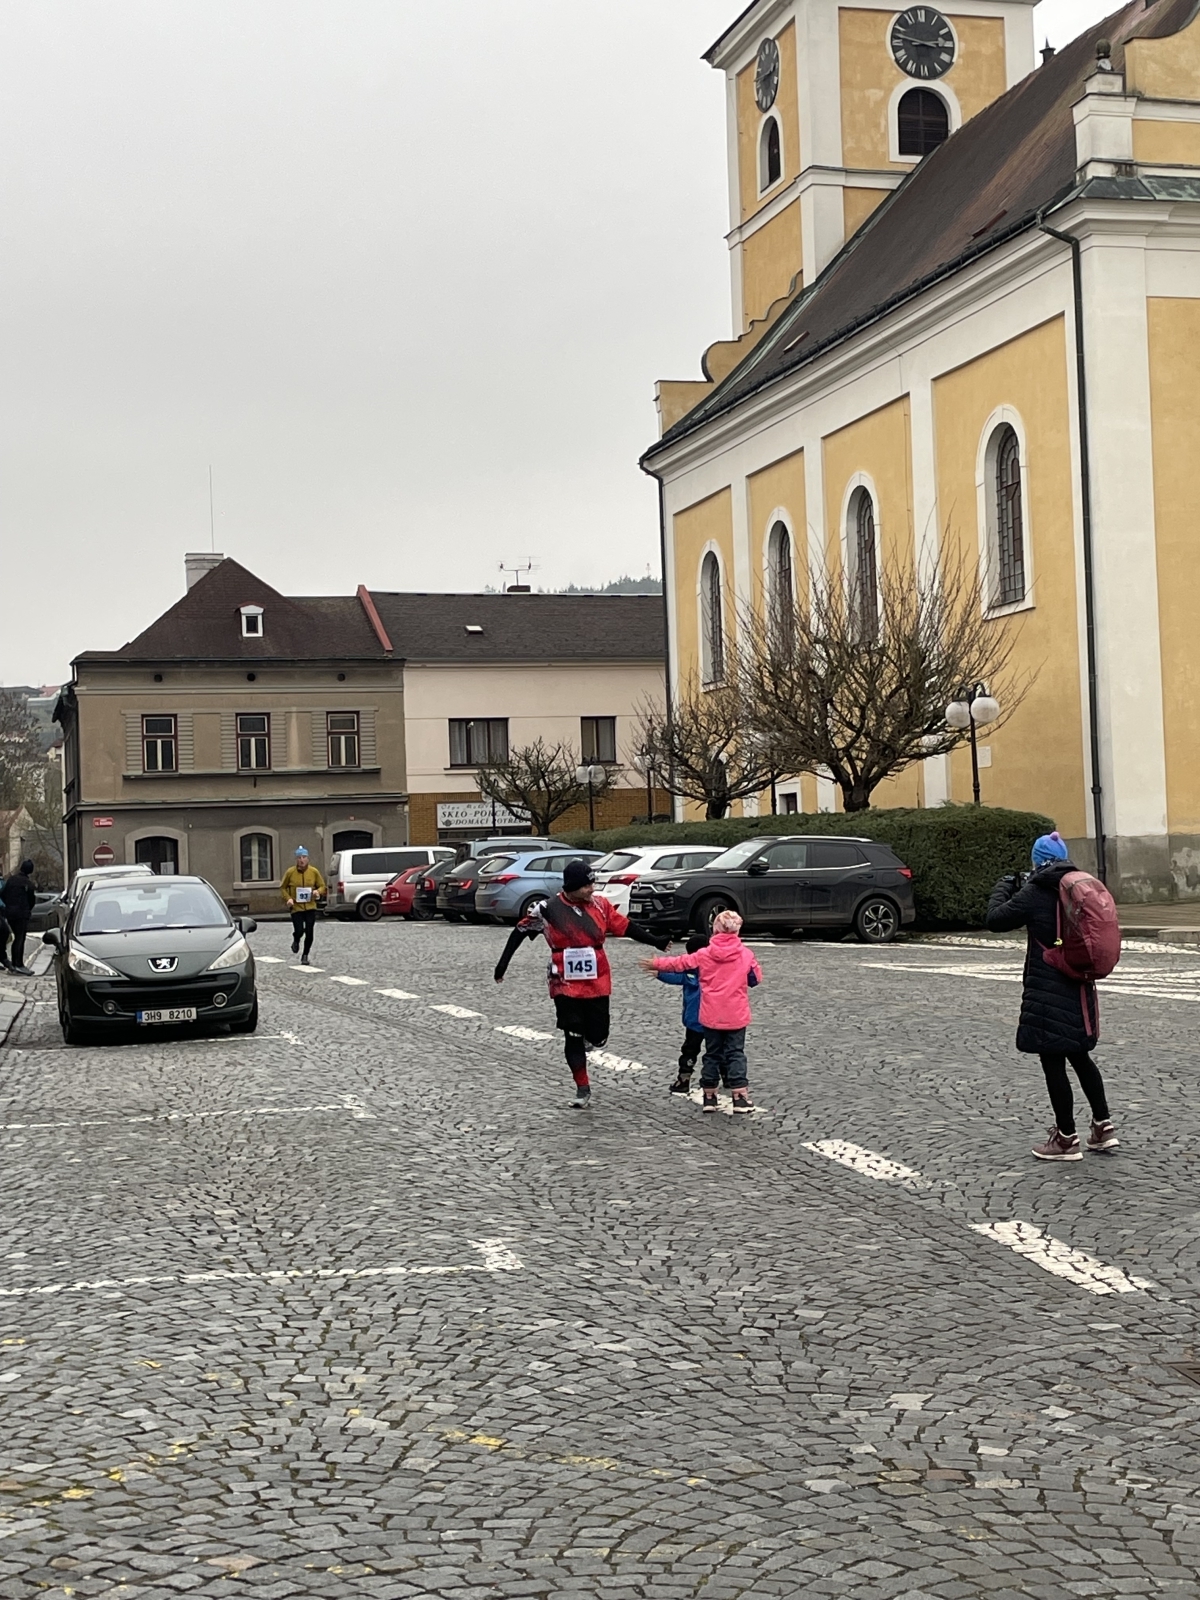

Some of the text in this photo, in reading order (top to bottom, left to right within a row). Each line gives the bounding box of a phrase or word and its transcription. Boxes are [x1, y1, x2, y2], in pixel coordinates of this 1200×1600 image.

[455, 817, 489, 825] DOMÁCÍ
[567, 960, 592, 973] 145
[144, 1009, 192, 1021] 3H9 8210
